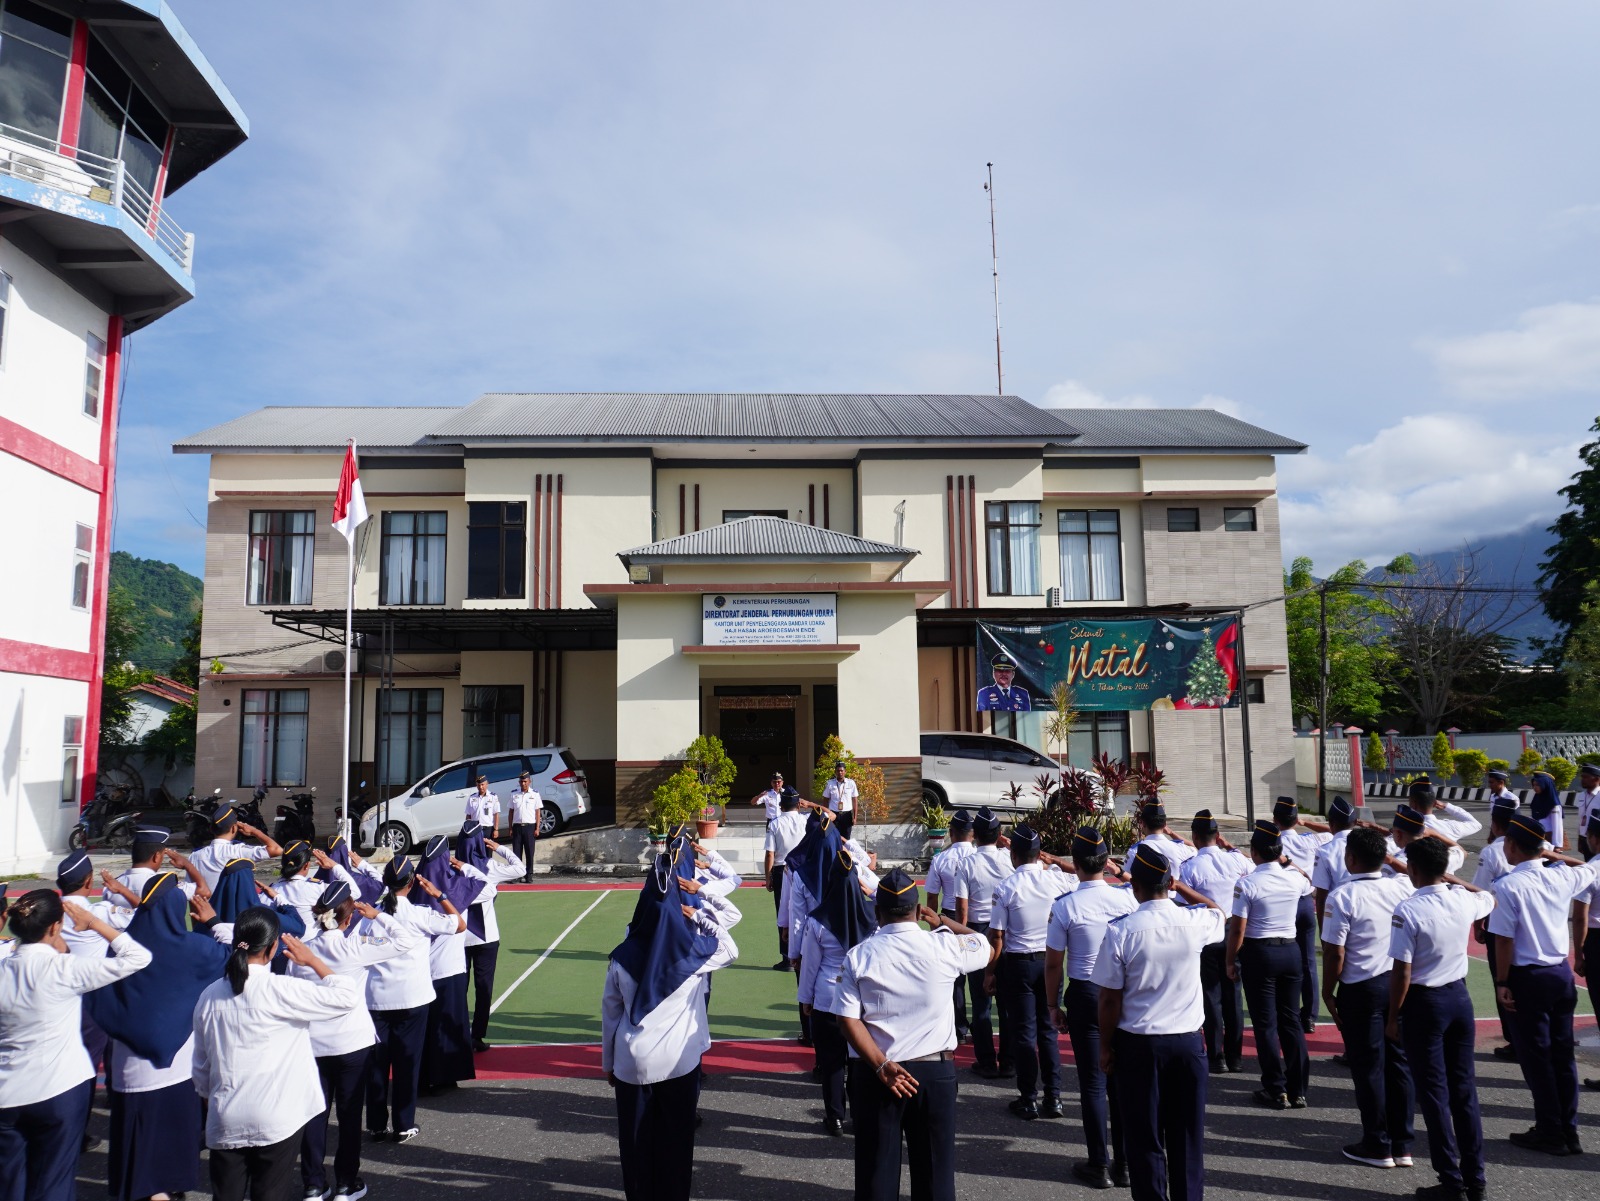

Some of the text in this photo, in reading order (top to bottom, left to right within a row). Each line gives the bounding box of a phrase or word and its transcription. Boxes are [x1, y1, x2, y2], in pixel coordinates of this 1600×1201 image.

[705, 609, 834, 618] DIREKTORAT JENDERAL PERHUBUNGAN UDARA
[1069, 626, 1105, 640] Selamat
[1066, 640, 1149, 686] Natal
[1117, 682, 1133, 692] Baru
